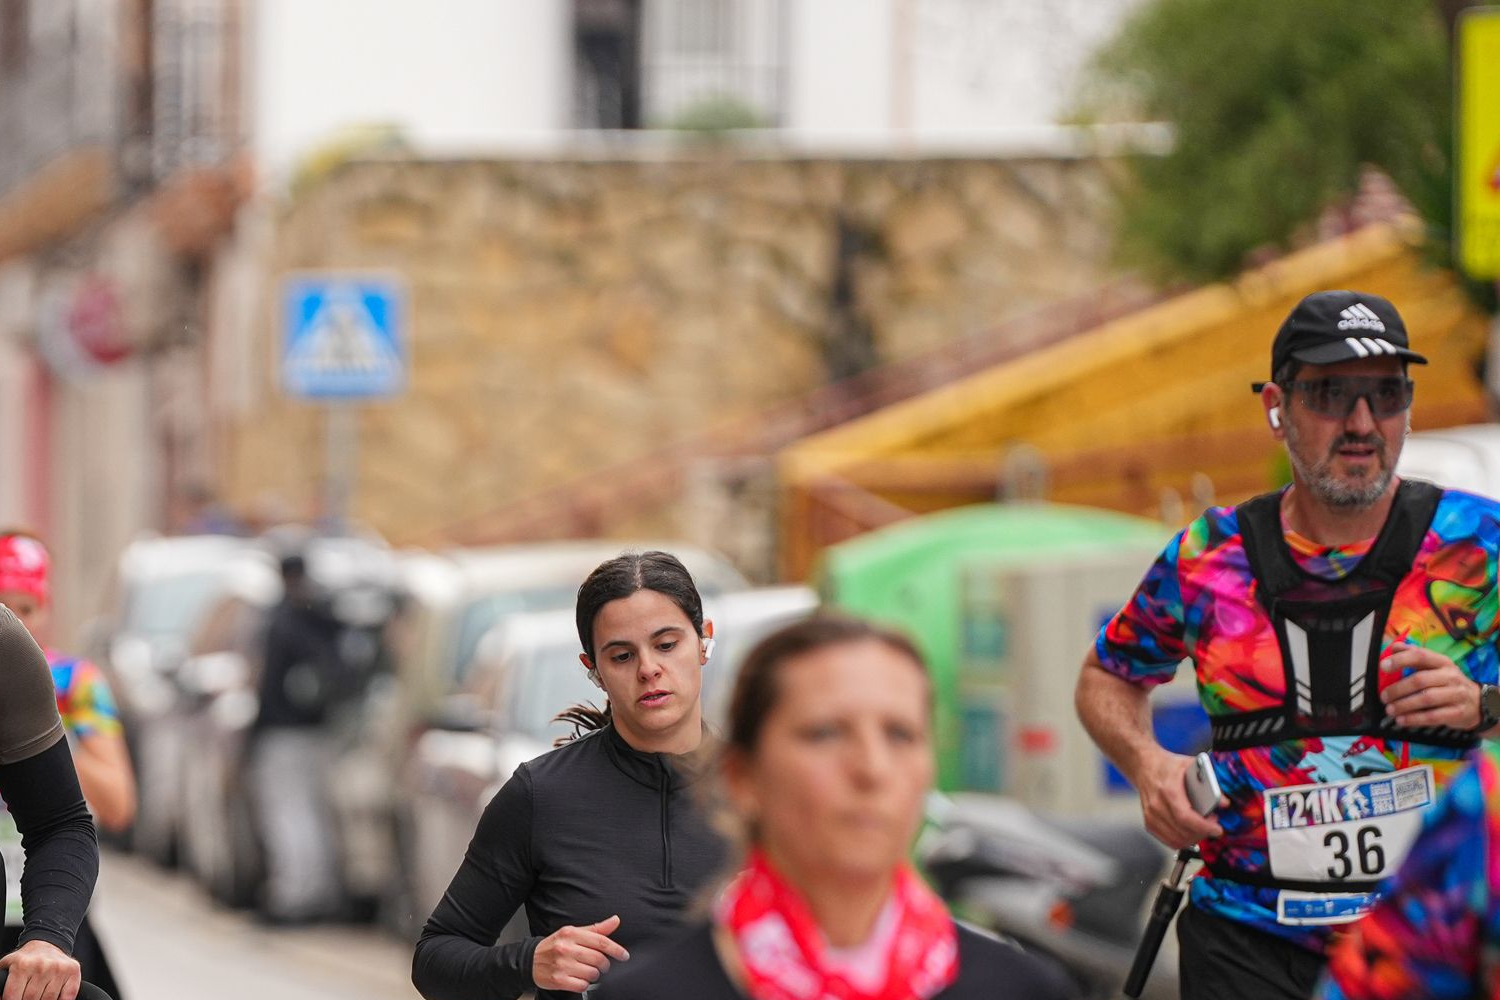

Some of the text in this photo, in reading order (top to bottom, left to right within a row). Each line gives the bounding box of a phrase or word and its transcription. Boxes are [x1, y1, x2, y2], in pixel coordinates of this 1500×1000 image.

[1337, 317, 1386, 333] adidas
[1288, 787, 1344, 827] 21K
[1323, 825, 1386, 880] 36
